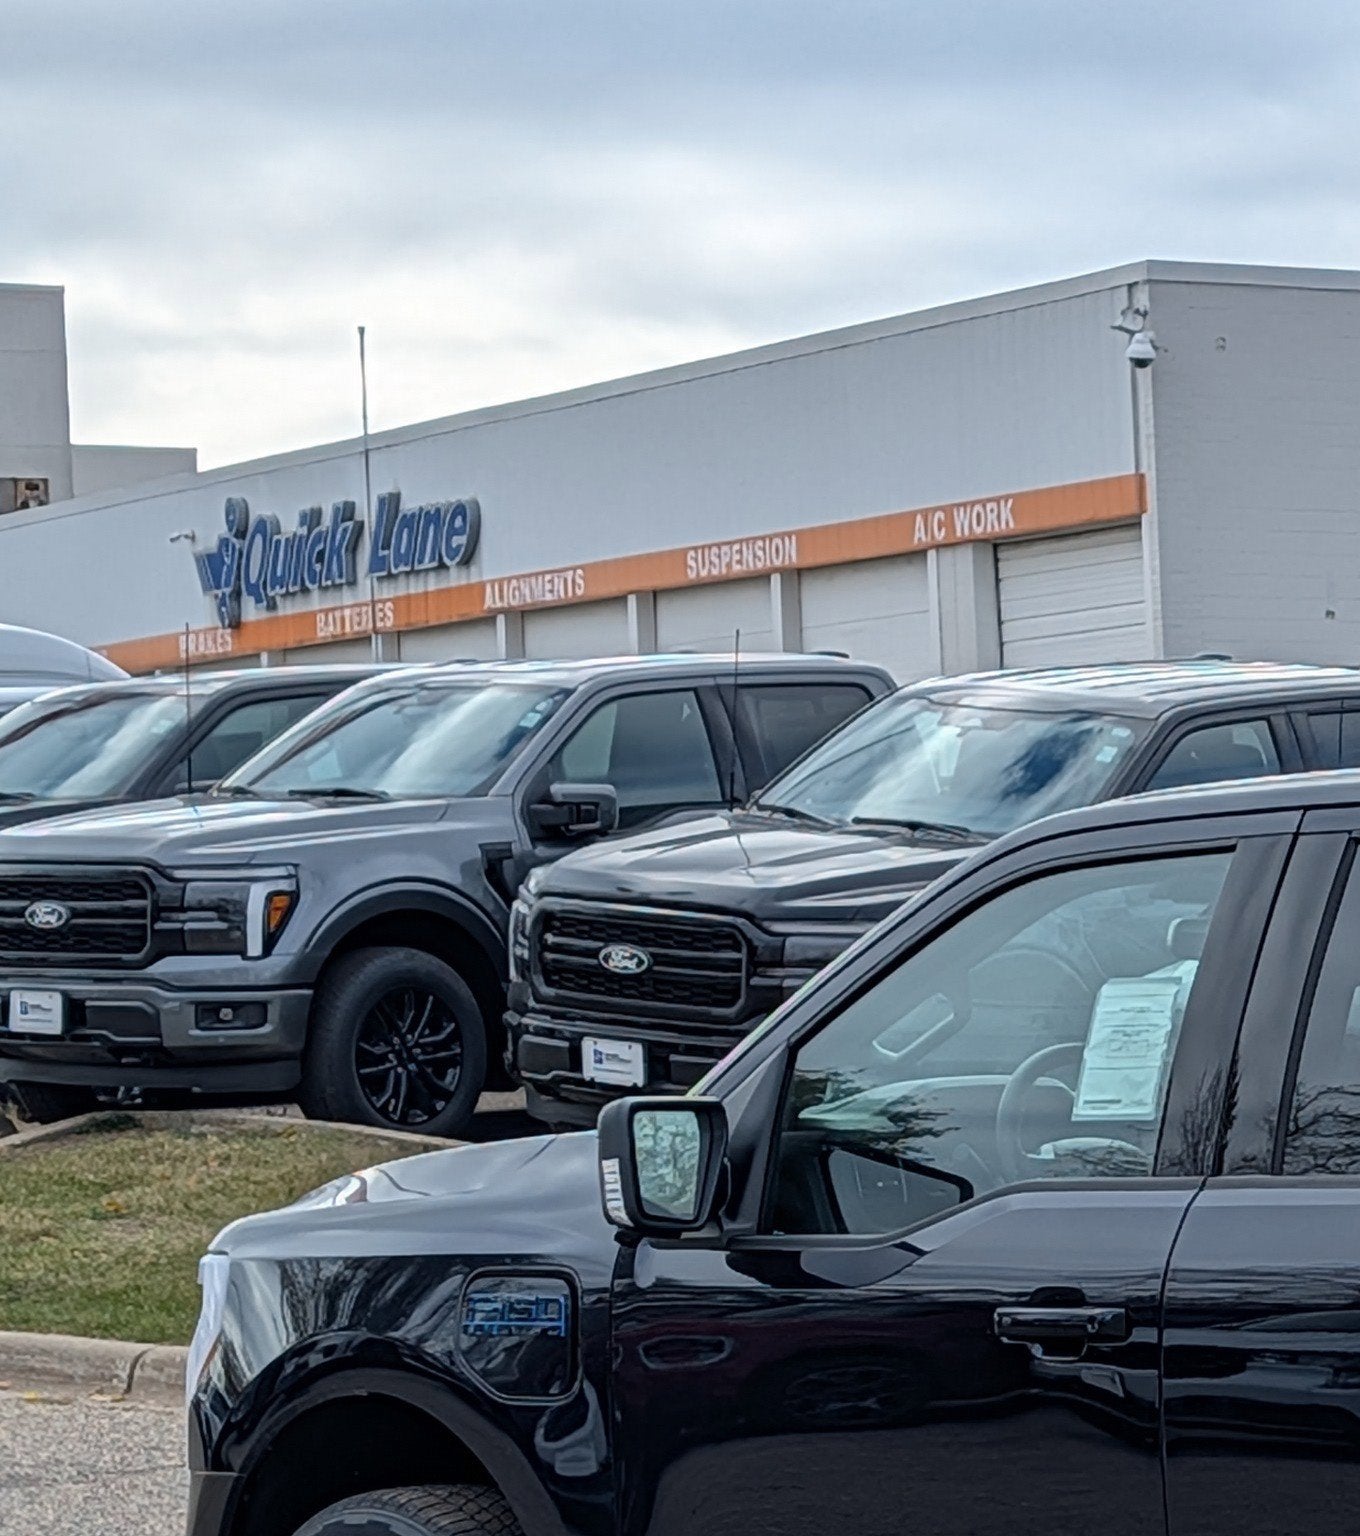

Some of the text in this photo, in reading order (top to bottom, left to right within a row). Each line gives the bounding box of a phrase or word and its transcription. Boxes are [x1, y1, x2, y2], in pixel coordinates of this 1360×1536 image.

[913, 498, 1015, 545] A/C WORK
[241, 491, 478, 609] Quick Lane
[686, 533, 798, 579] SUSPENSION
[483, 568, 585, 610] ALIGNMENTS
[316, 601, 394, 637] BATTERES
